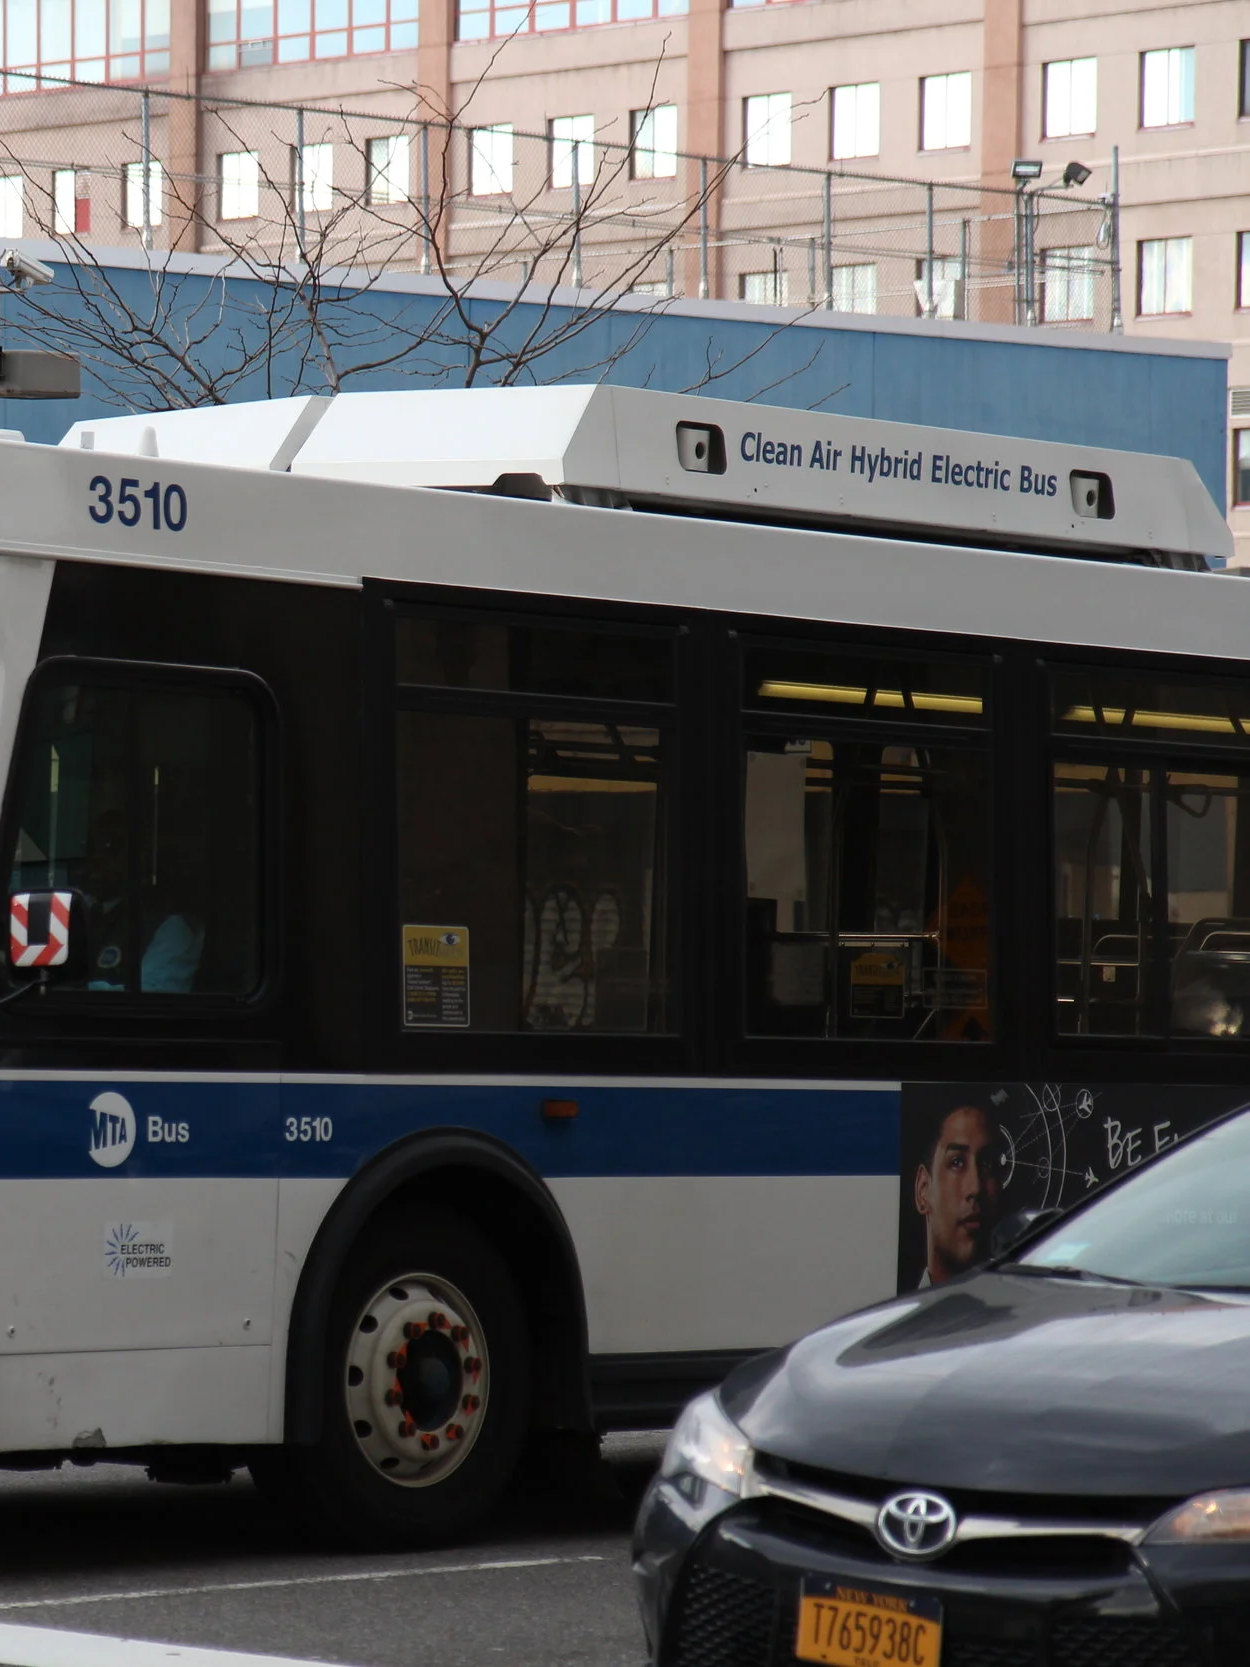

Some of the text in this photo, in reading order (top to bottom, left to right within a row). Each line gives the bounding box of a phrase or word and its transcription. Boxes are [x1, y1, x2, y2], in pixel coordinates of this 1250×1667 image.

[740, 432, 1058, 497] Clean Air Hybrid Electric Bus
[88, 475, 188, 532] 3510
[408, 938, 441, 957] TRANSIT
[89, 1108, 190, 1152] MTA Bus
[285, 1117, 333, 1142] 3510
[120, 1243, 171, 1269] ELECTRIC POWERED
[814, 1602, 926, 1666] T765938C
